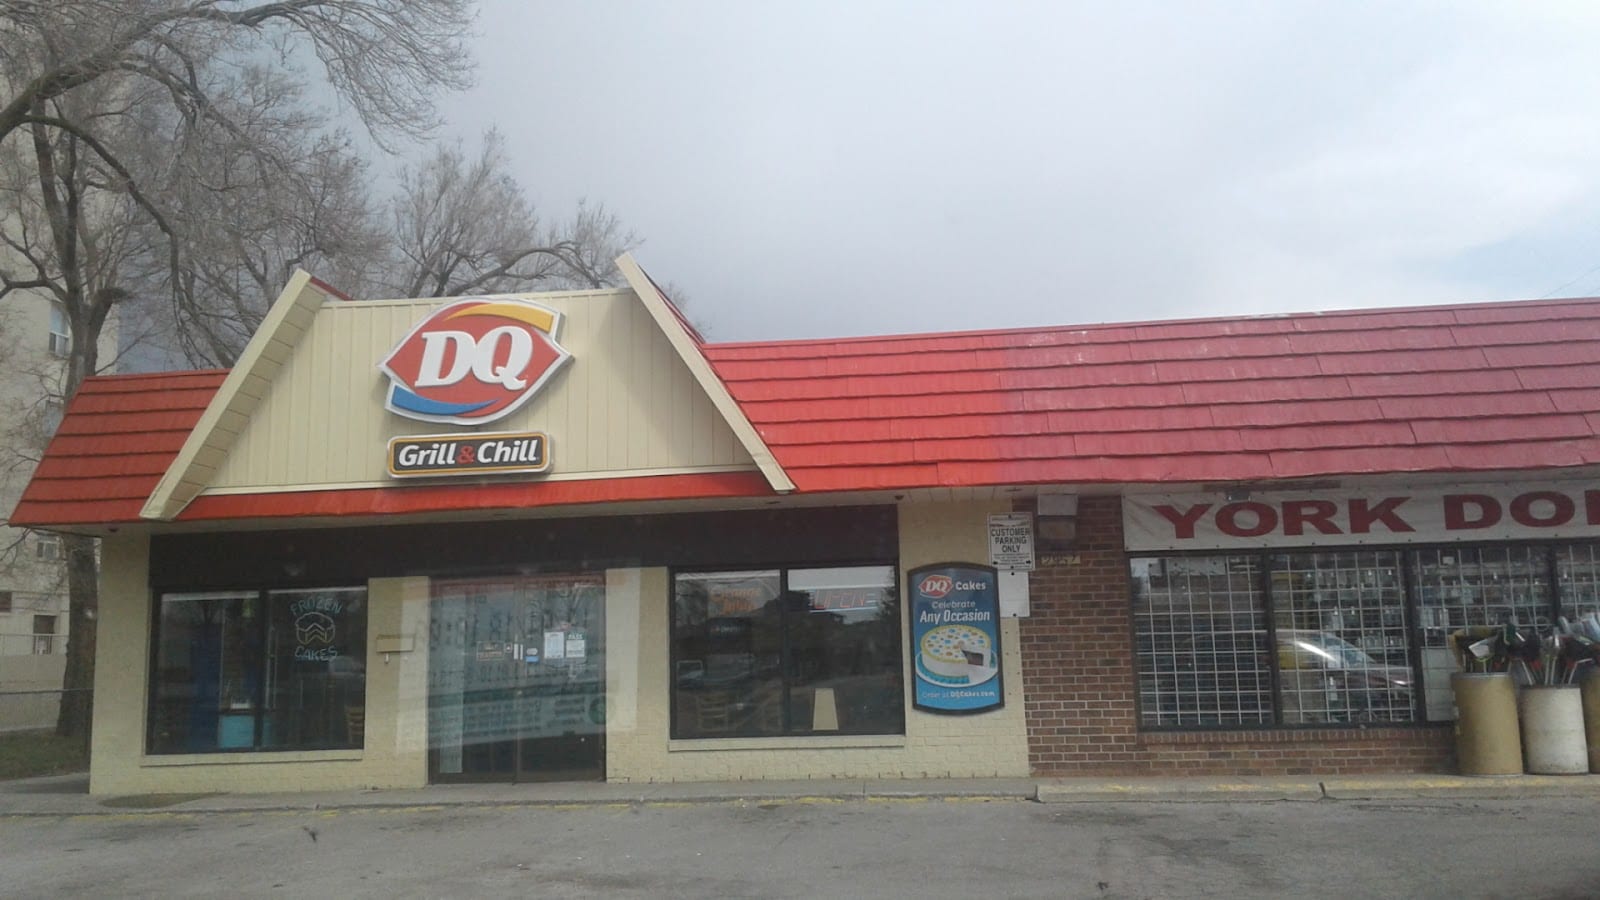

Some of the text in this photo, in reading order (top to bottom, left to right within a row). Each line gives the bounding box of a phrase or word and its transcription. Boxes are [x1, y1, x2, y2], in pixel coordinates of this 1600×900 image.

[415, 325, 533, 391] DQ
[398, 439, 538, 466] Grill & Chill
[1153, 495, 1416, 539] YORK
[991, 528, 1030, 536] CUSTOMER
[995, 536, 1027, 544] PARKING
[925, 580, 987, 593] DQ Cakes
[291, 598, 343, 616] FROZEN
[932, 601, 976, 609] Celebrate
[920, 609, 991, 624] Any Occasion
[295, 646, 338, 662] CAKES
